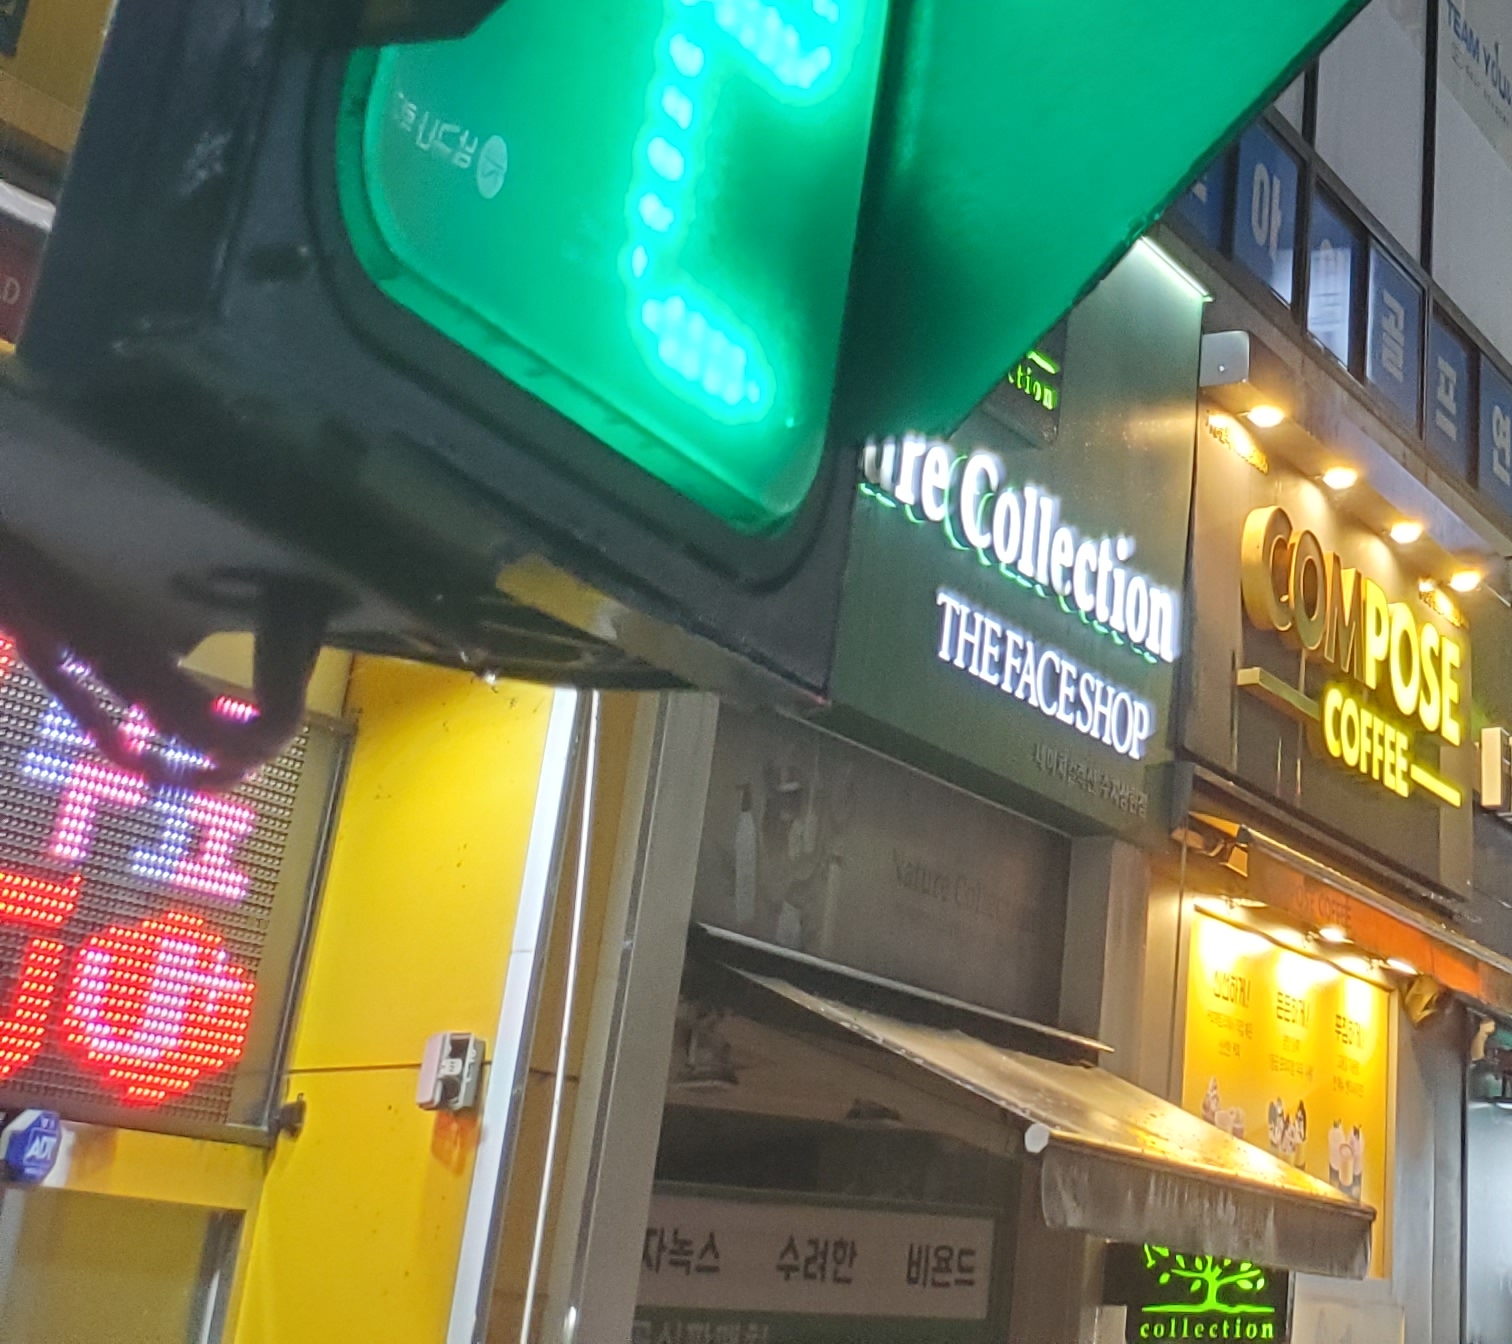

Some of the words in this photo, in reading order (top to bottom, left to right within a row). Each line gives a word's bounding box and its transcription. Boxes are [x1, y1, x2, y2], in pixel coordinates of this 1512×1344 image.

[960, 448, 1181, 663] Collection
[1241, 506, 1462, 747] COMPOSE
[1323, 687, 1410, 799] COFFEE
[24, 1134, 57, 1163] ADT
[773, 1229, 858, 1286] 수려한
[906, 1241, 978, 1290] 비욘드
[1139, 1315, 1275, 1340] collection
